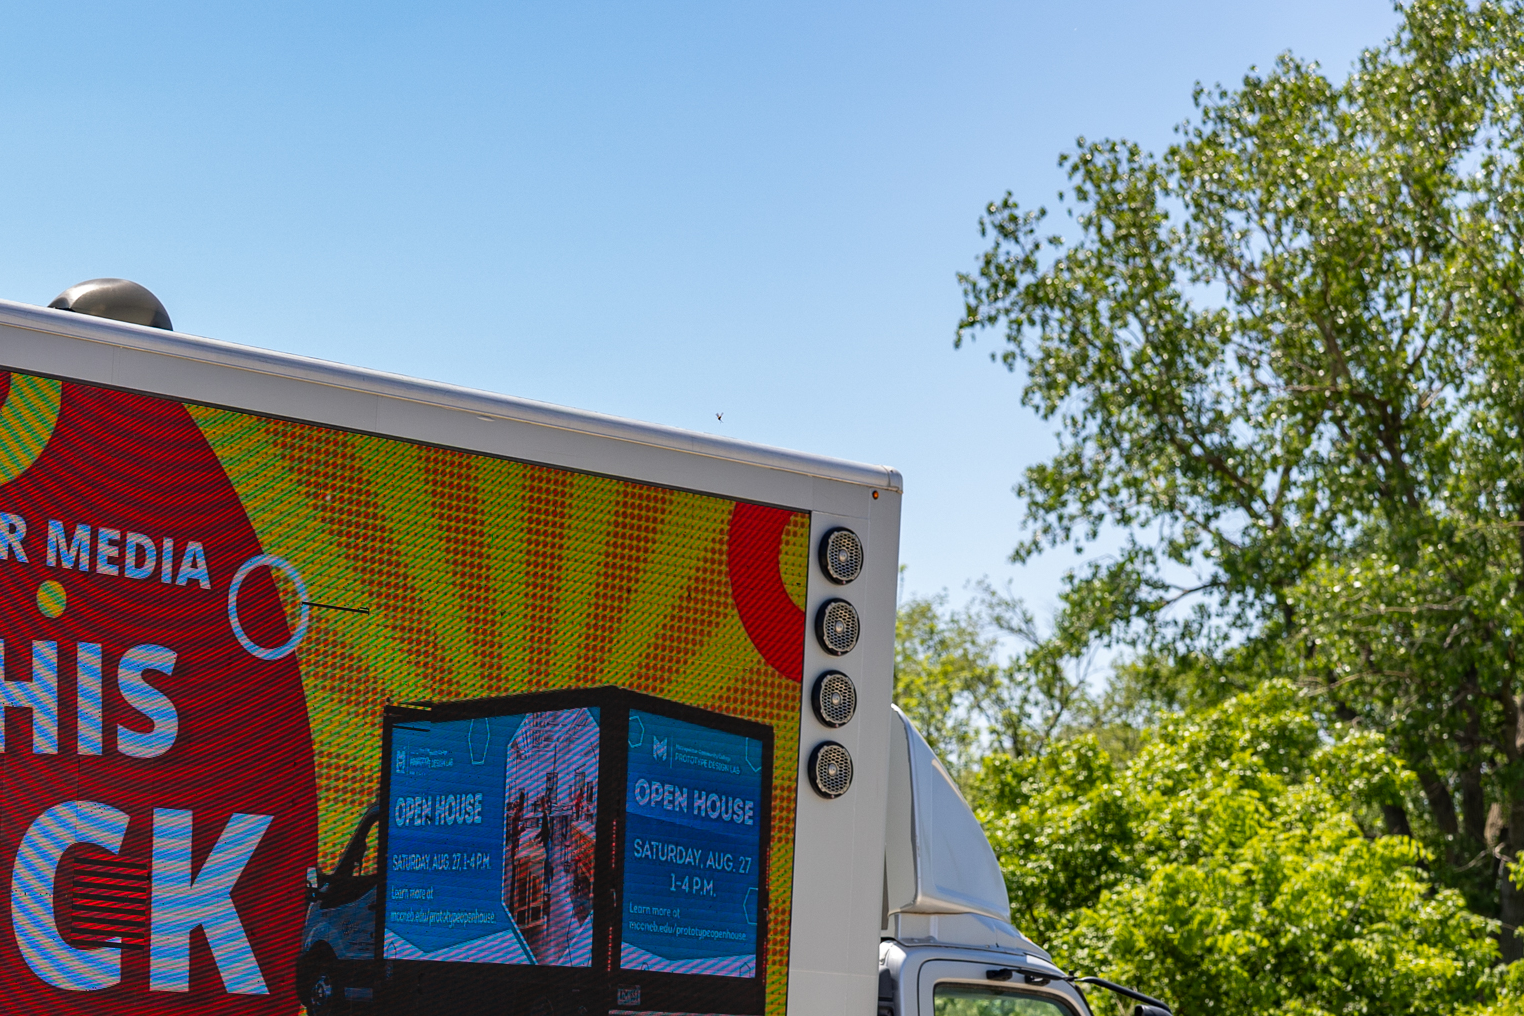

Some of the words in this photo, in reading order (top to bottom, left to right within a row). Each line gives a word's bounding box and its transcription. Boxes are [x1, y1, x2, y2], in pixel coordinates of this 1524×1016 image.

[46, 519, 212, 590] MEDIA
[395, 796, 432, 827] OPEN
[435, 792, 483, 826] HOUSE
[634, 778, 688, 814] OPEN
[693, 790, 754, 825] HOUSE
[633, 838, 704, 869] SATURDAY,
[705, 850, 736, 873] AUG.
[738, 856, 752, 874] 27
[669, 873, 690, 894] 1-4
[692, 876, 716, 898] P.M.
[629, 901, 651, 915] Learn
[651, 906, 671, 918] more
[672, 907, 681, 919] at
